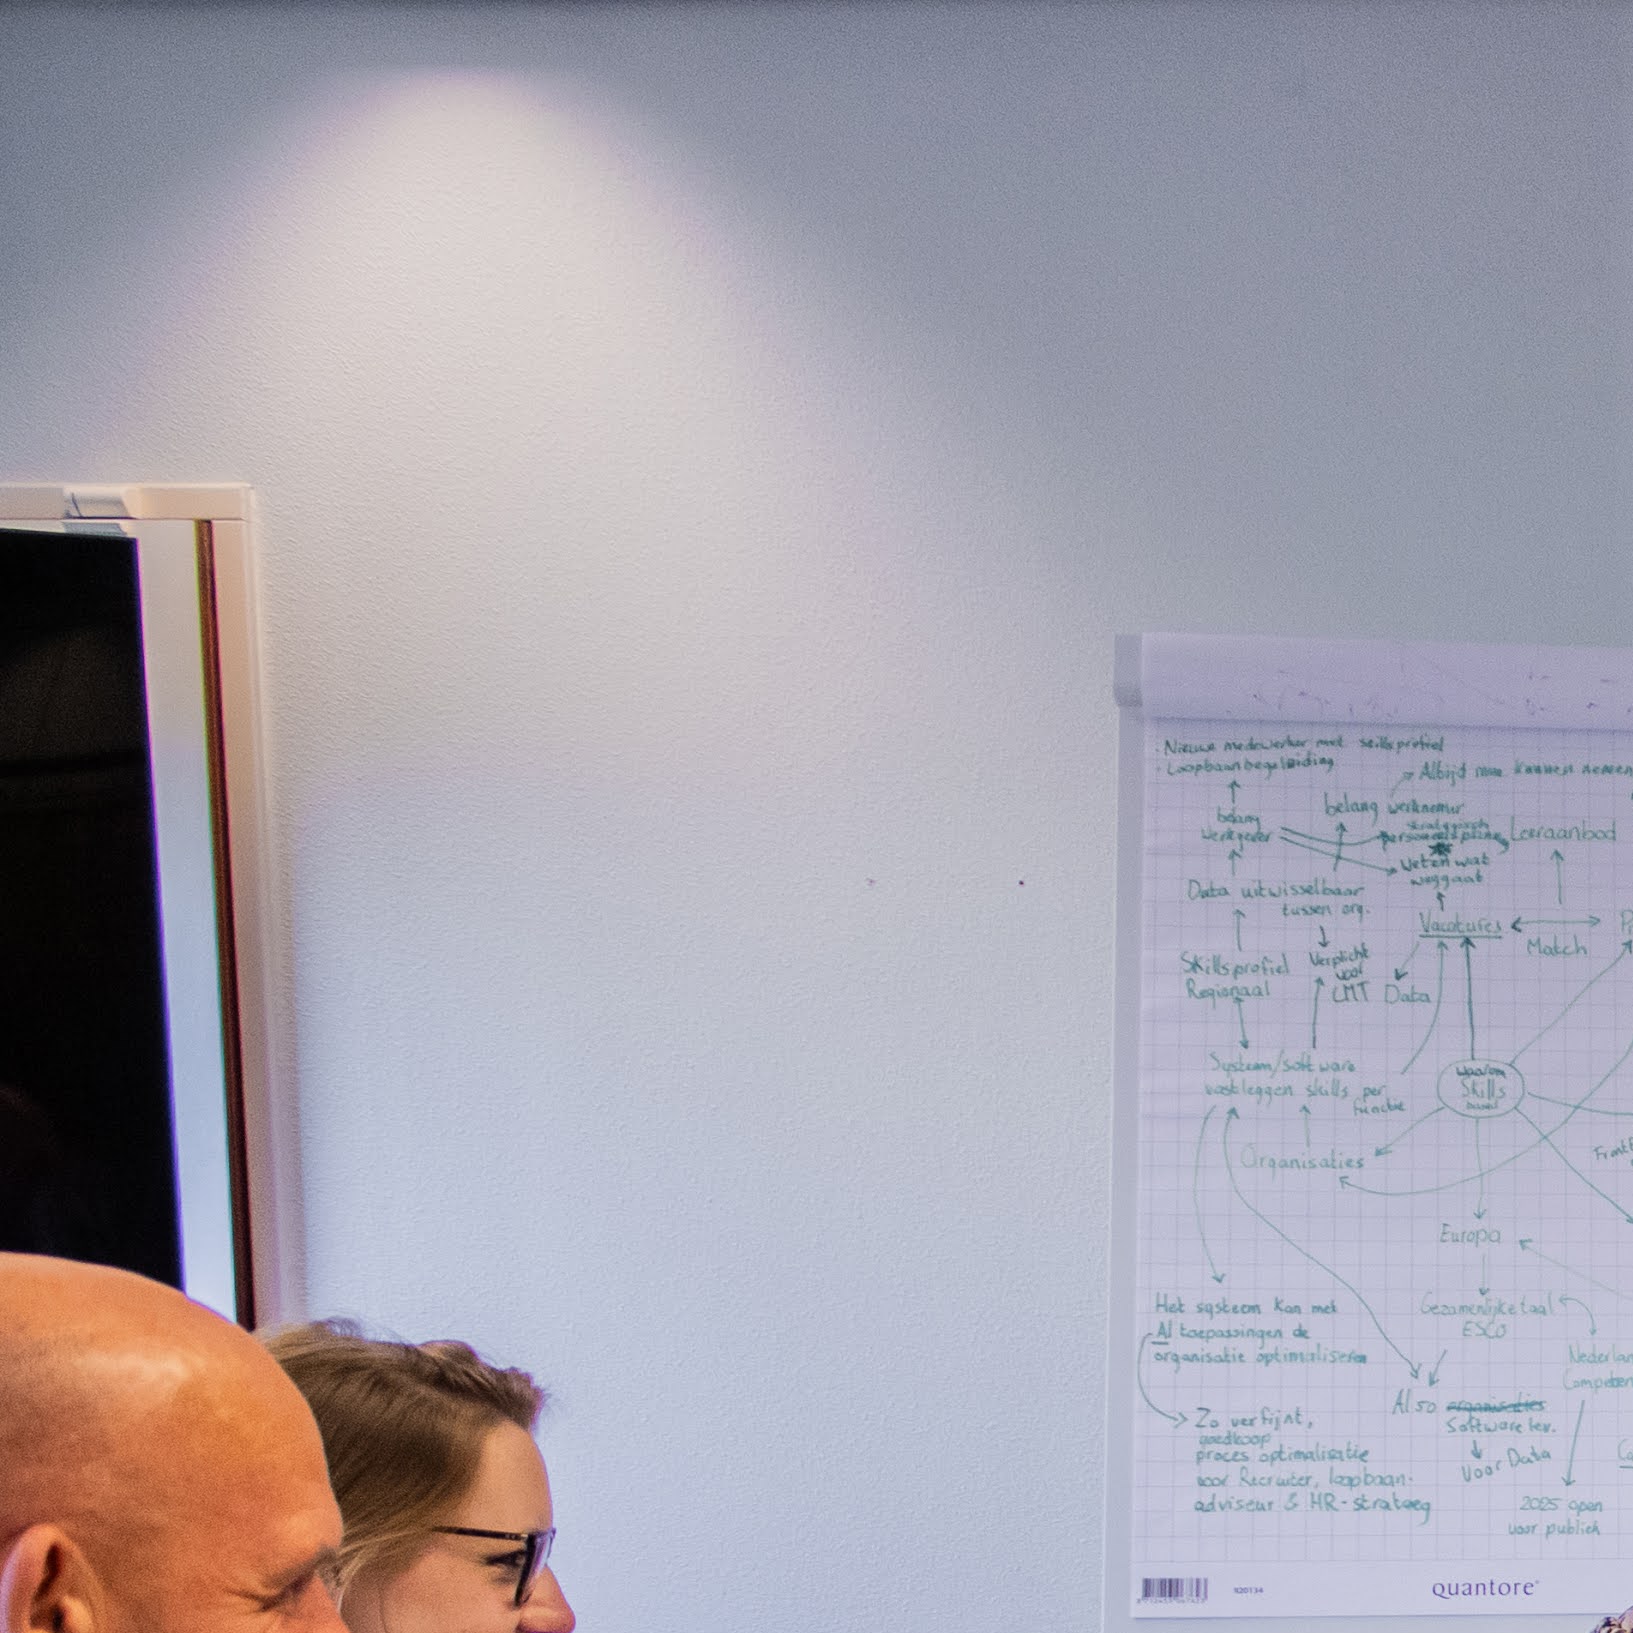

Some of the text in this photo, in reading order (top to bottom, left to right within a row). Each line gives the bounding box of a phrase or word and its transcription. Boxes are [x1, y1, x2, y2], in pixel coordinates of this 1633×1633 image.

[1324, 792, 1378, 826] belang
[1188, 876, 1365, 901] Data uitwisselbaar
[1282, 902, 1332, 917] tussen
[1527, 934, 1588, 957] Match
[1186, 978, 1271, 1009] Regionaal
[1384, 984, 1431, 1005] Data
[1240, 1143, 1365, 1181] Organisaties
[1439, 1224, 1501, 1248] Europa
[1155, 1292, 1186, 1315] Het
[1311, 1299, 1338, 1315] met
[1463, 1321, 1507, 1339] ESCO
[1154, 1349, 1245, 1375] organisatie
[1195, 1449, 1250, 1467] proces
[1507, 1445, 1552, 1468] Data
[1193, 1494, 1274, 1514] adviseur
[1568, 1498, 1603, 1520] open
